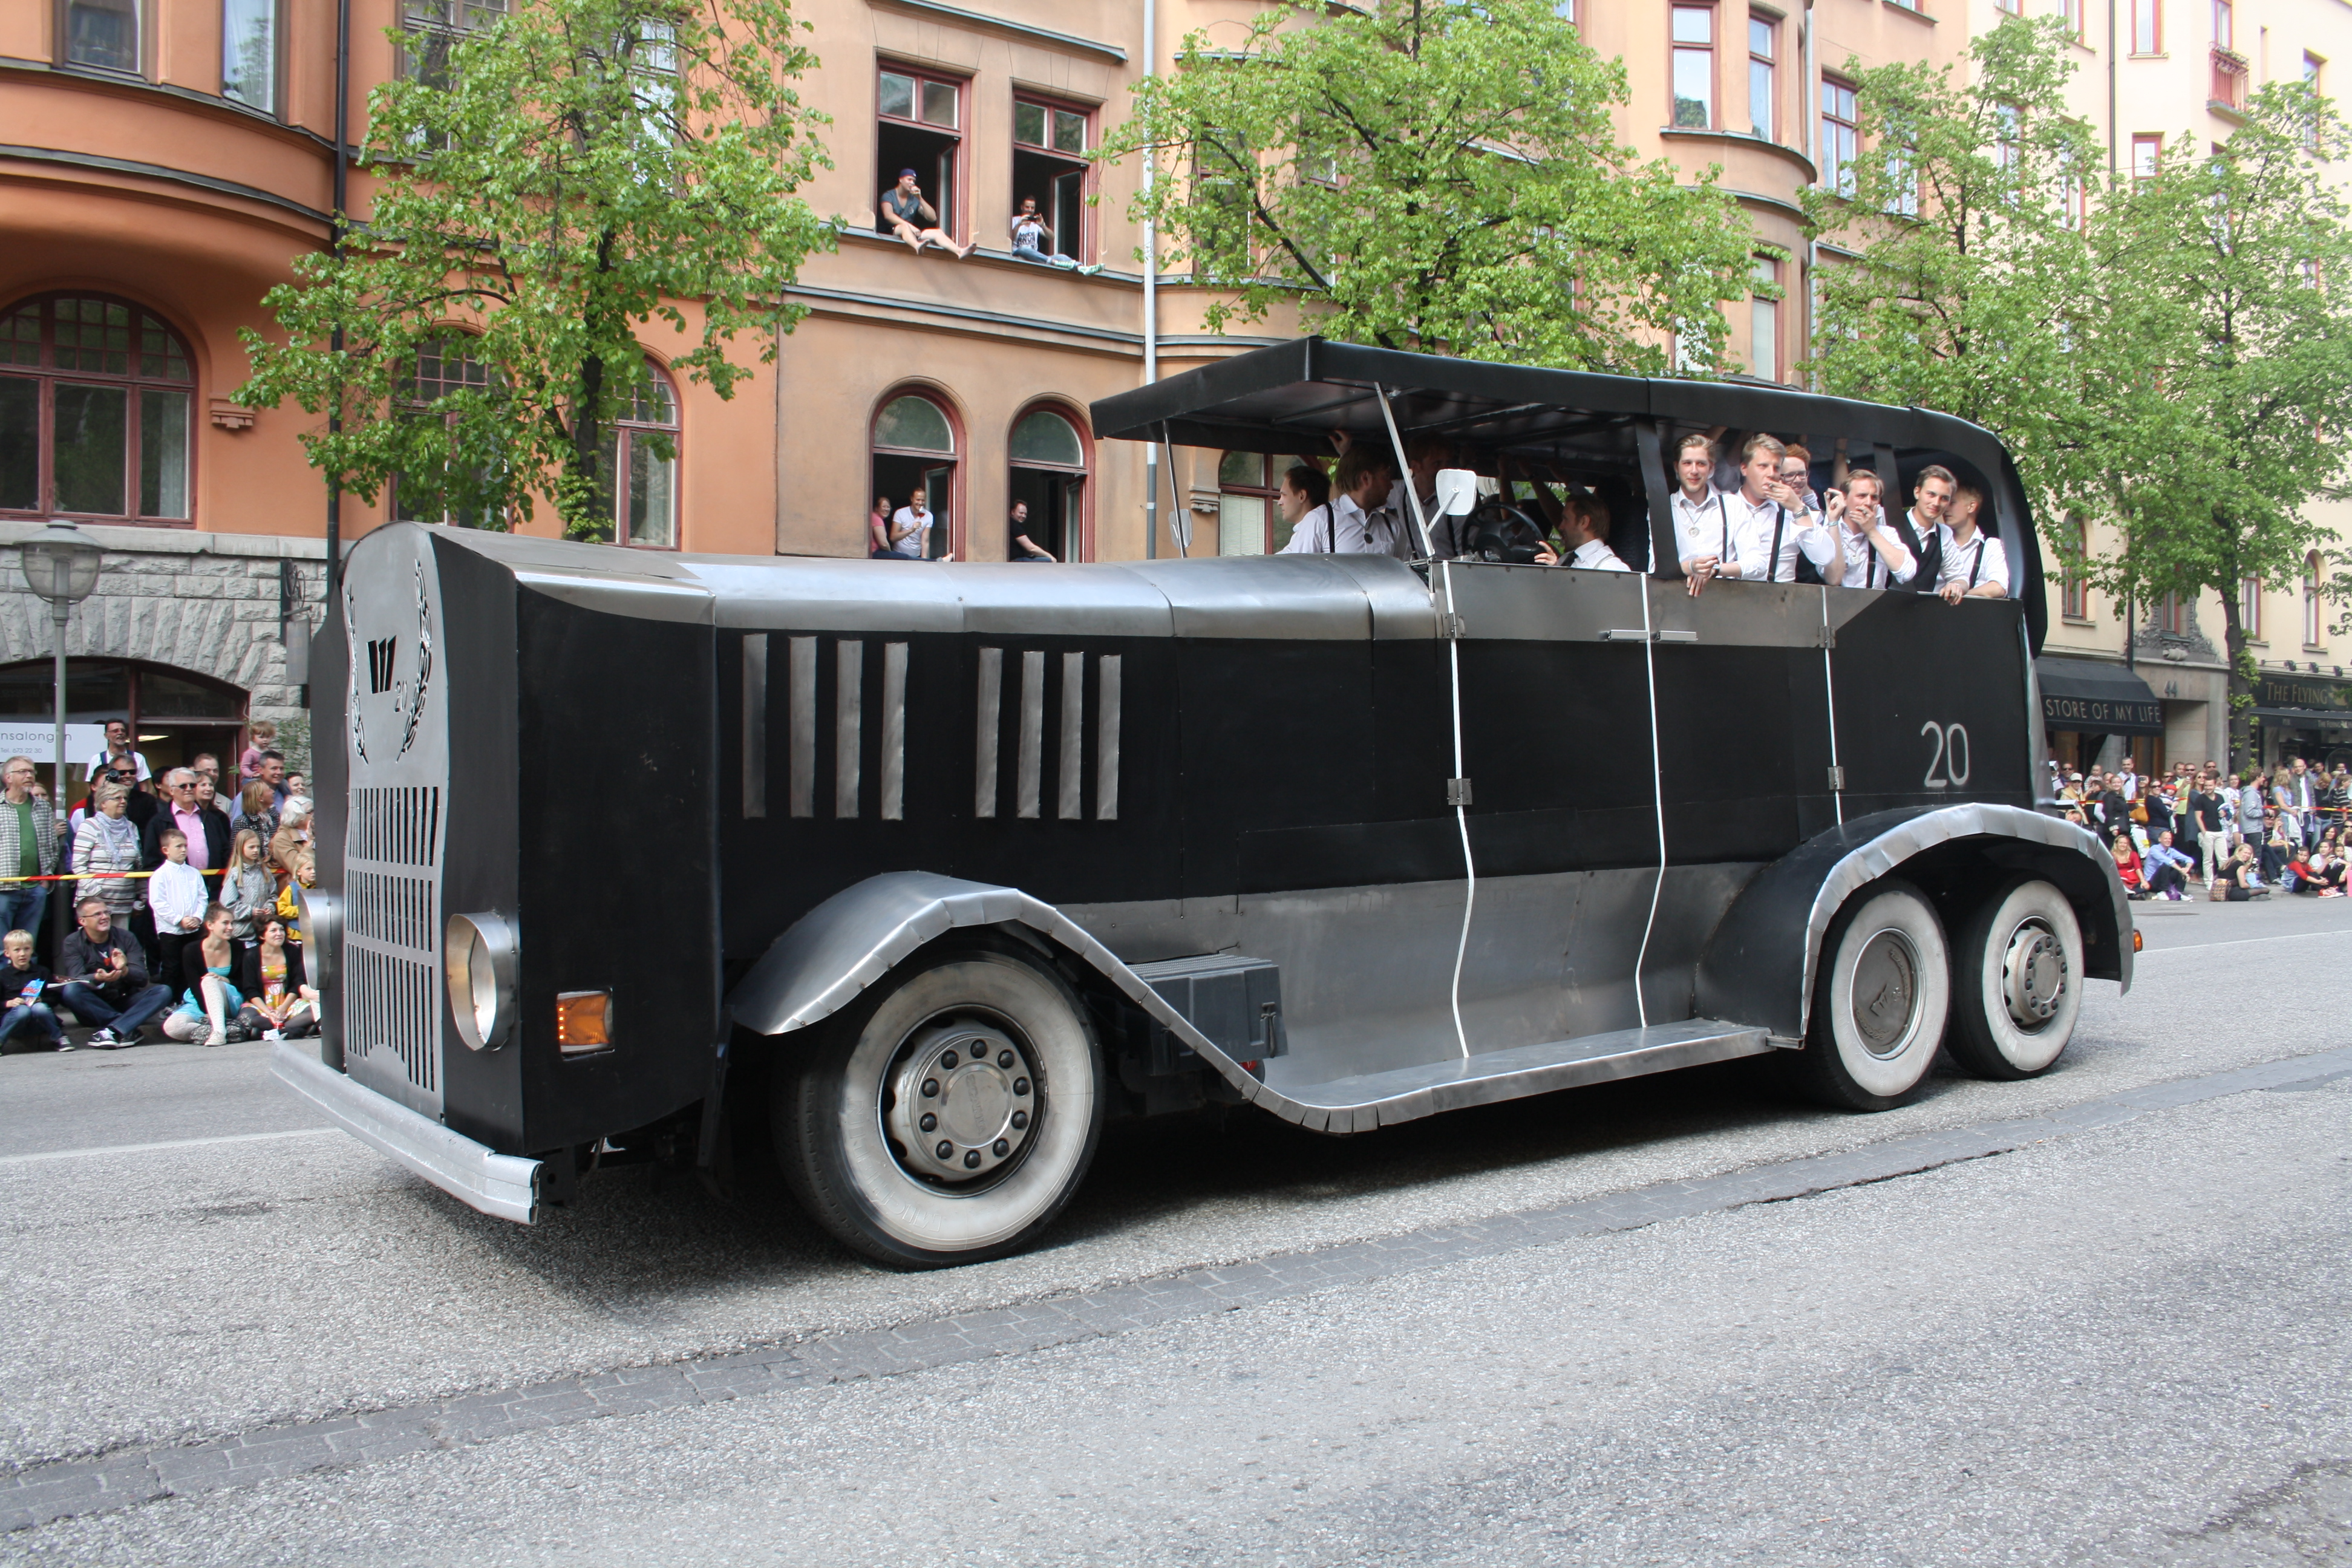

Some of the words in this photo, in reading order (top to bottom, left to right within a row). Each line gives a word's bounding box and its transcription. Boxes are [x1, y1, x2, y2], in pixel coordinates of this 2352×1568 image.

[2164, 680, 2178, 697] 44
[2266, 682, 2288, 701] THE
[2292, 684, 2328, 704] FLYING
[2045, 699, 2087, 719] STORE
[2092, 703, 2109, 720] OF
[2115, 705, 2133, 721] MY
[2138, 706, 2161, 723] LIFE
[1, 731, 72, 743] nsalongn
[1921, 720, 1969, 787] 20
